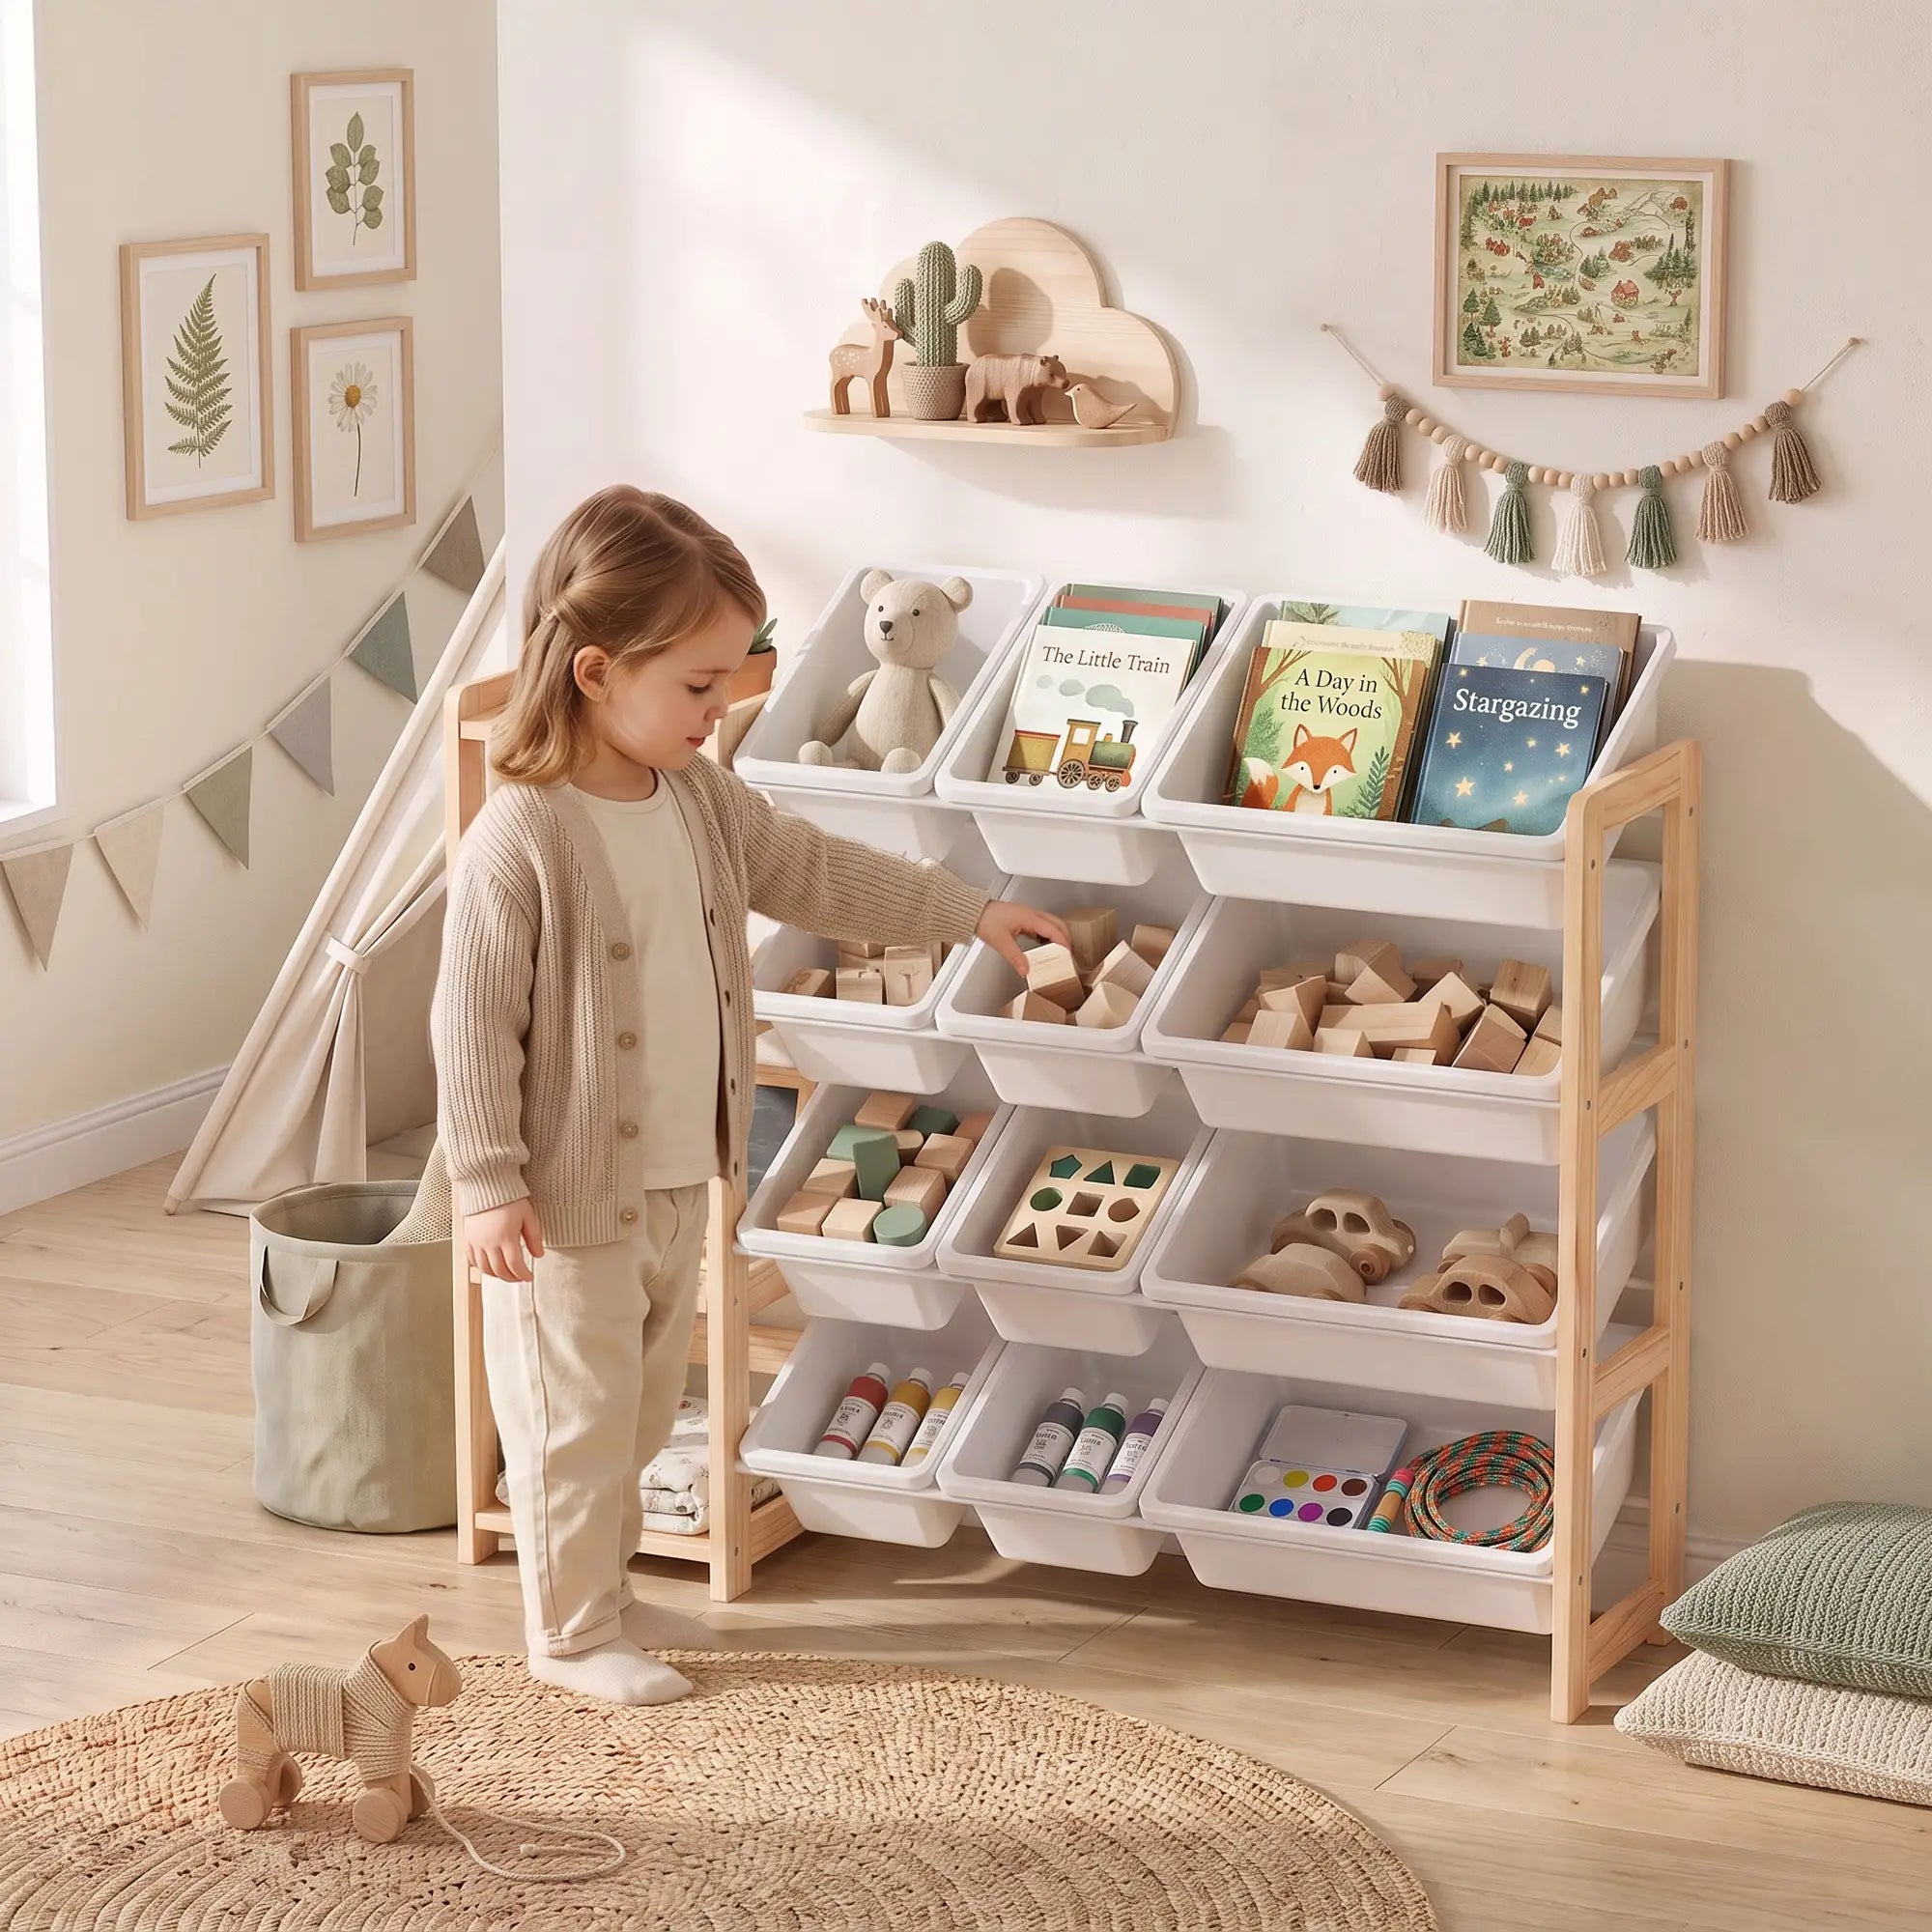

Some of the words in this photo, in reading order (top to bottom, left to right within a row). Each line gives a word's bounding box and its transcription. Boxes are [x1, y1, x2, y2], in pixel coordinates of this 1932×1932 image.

[1042, 645, 1073, 665] The
[1077, 649, 1122, 669] Little
[1127, 654, 1171, 674] Train
[1294, 668, 1310, 687] A
[1315, 669, 1354, 696] Day
[1358, 674, 1378, 693] in
[1281, 691, 1311, 712] the
[1318, 695, 1382, 719] Woods
[1453, 688, 1582, 729] Stargazing
